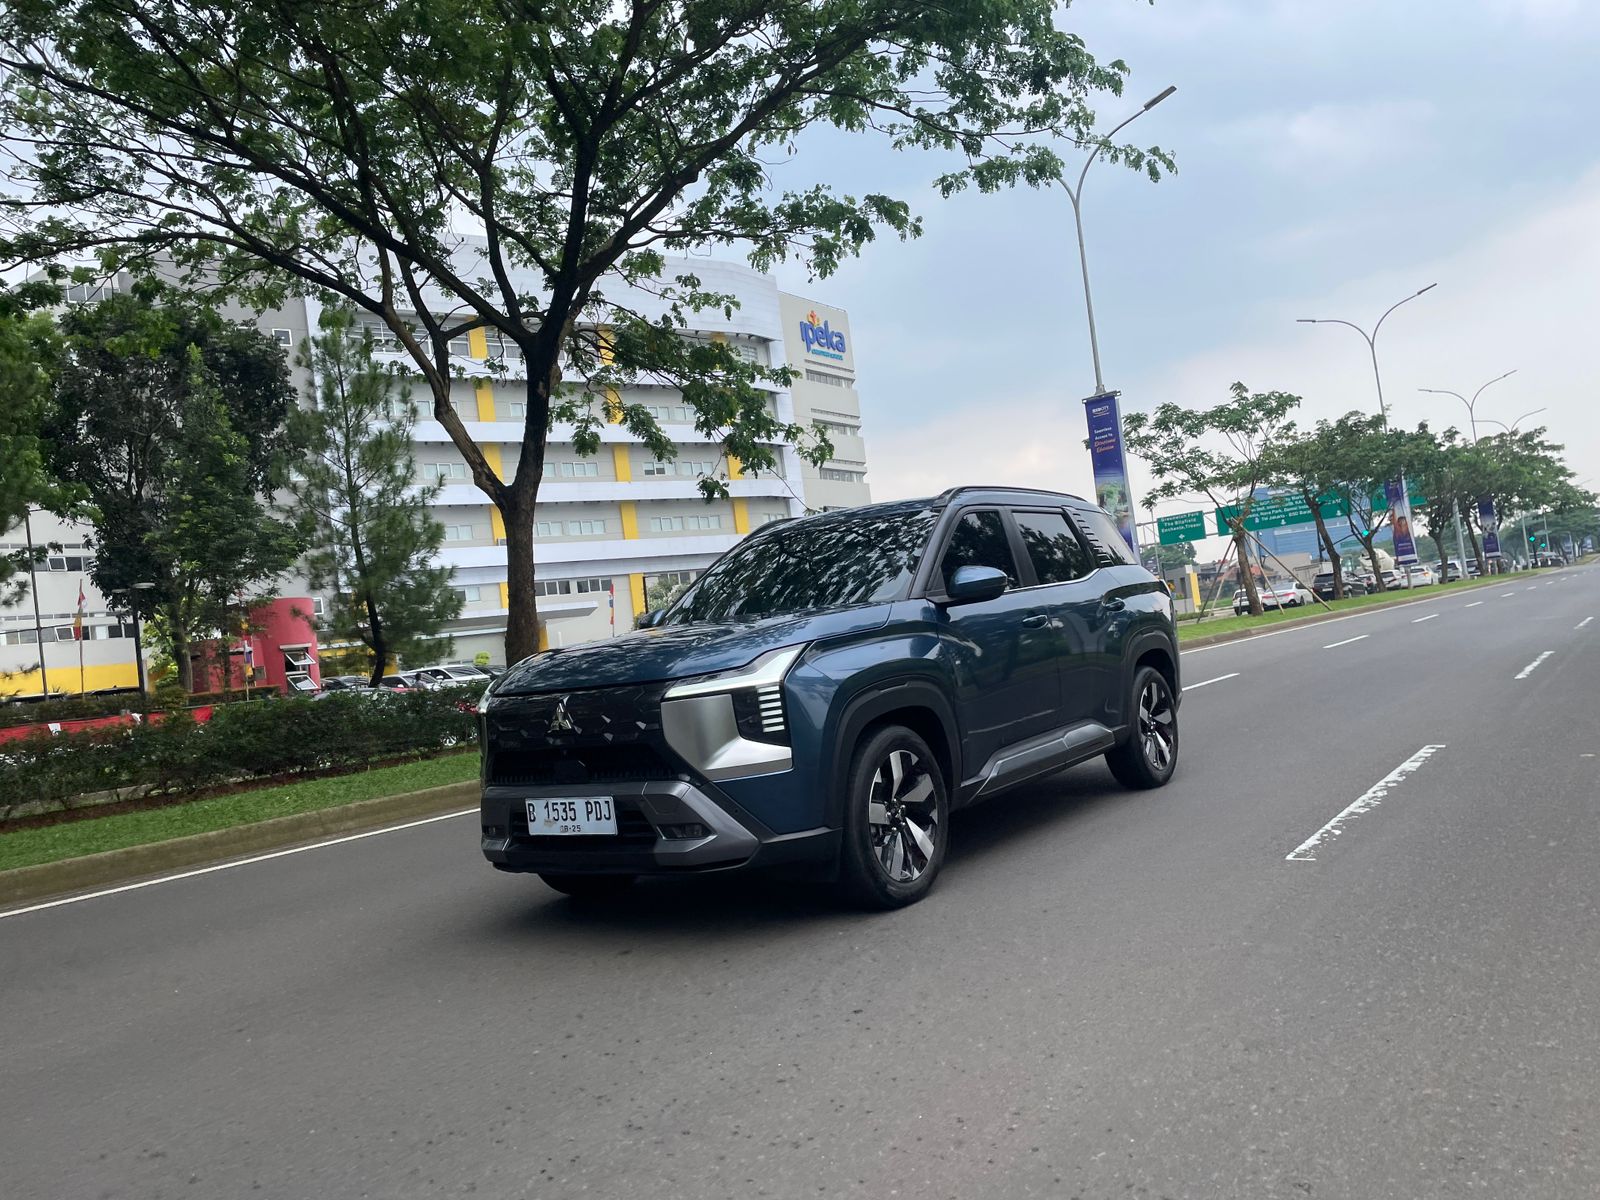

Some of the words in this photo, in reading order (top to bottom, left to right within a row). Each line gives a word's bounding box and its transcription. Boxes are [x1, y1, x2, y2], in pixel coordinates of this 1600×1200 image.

[527, 802, 536, 822] B
[544, 801, 577, 821] 1535
[585, 800, 611, 821] PDJ
